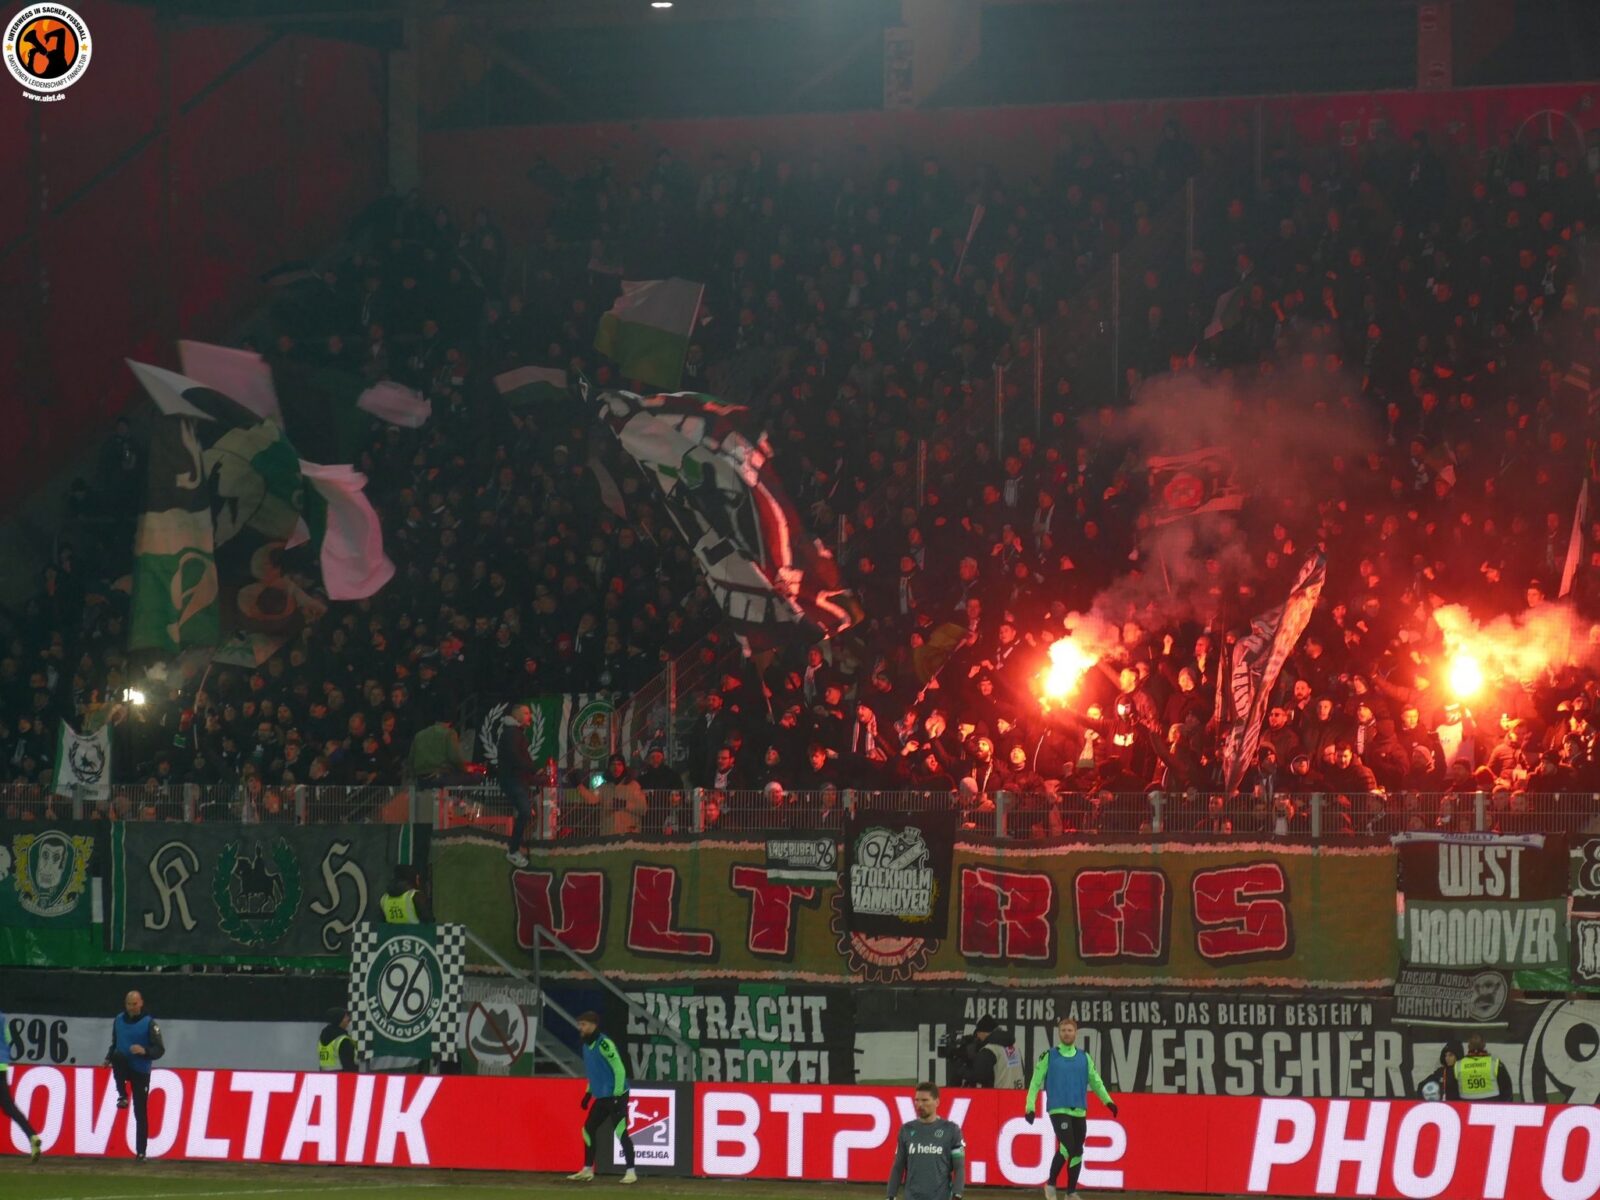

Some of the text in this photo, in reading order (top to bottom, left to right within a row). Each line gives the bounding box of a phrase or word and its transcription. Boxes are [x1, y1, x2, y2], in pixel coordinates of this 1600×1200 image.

[851, 865, 933, 888] STOCKHOLM
[1438, 843, 1526, 899] WEST
[851, 886, 931, 912] HANNOVER
[387, 939, 425, 957] HSV
[1410, 908, 1558, 966] HANNOVER
[368, 996, 440, 1037] Hannover 96
[624, 992, 827, 1043] EINTRACHT
[963, 997, 1373, 1027] ABER EINS, ABER EINS, DAS BLEIBT BESTEH'N
[1467, 1078, 1486, 1090] 590
[6, 1065, 443, 1166] OVOLTAIK
[652, 1121, 667, 1143] 2
[619, 1150, 669, 1159] BDESLIGA
[917, 1144, 943, 1155] heise
